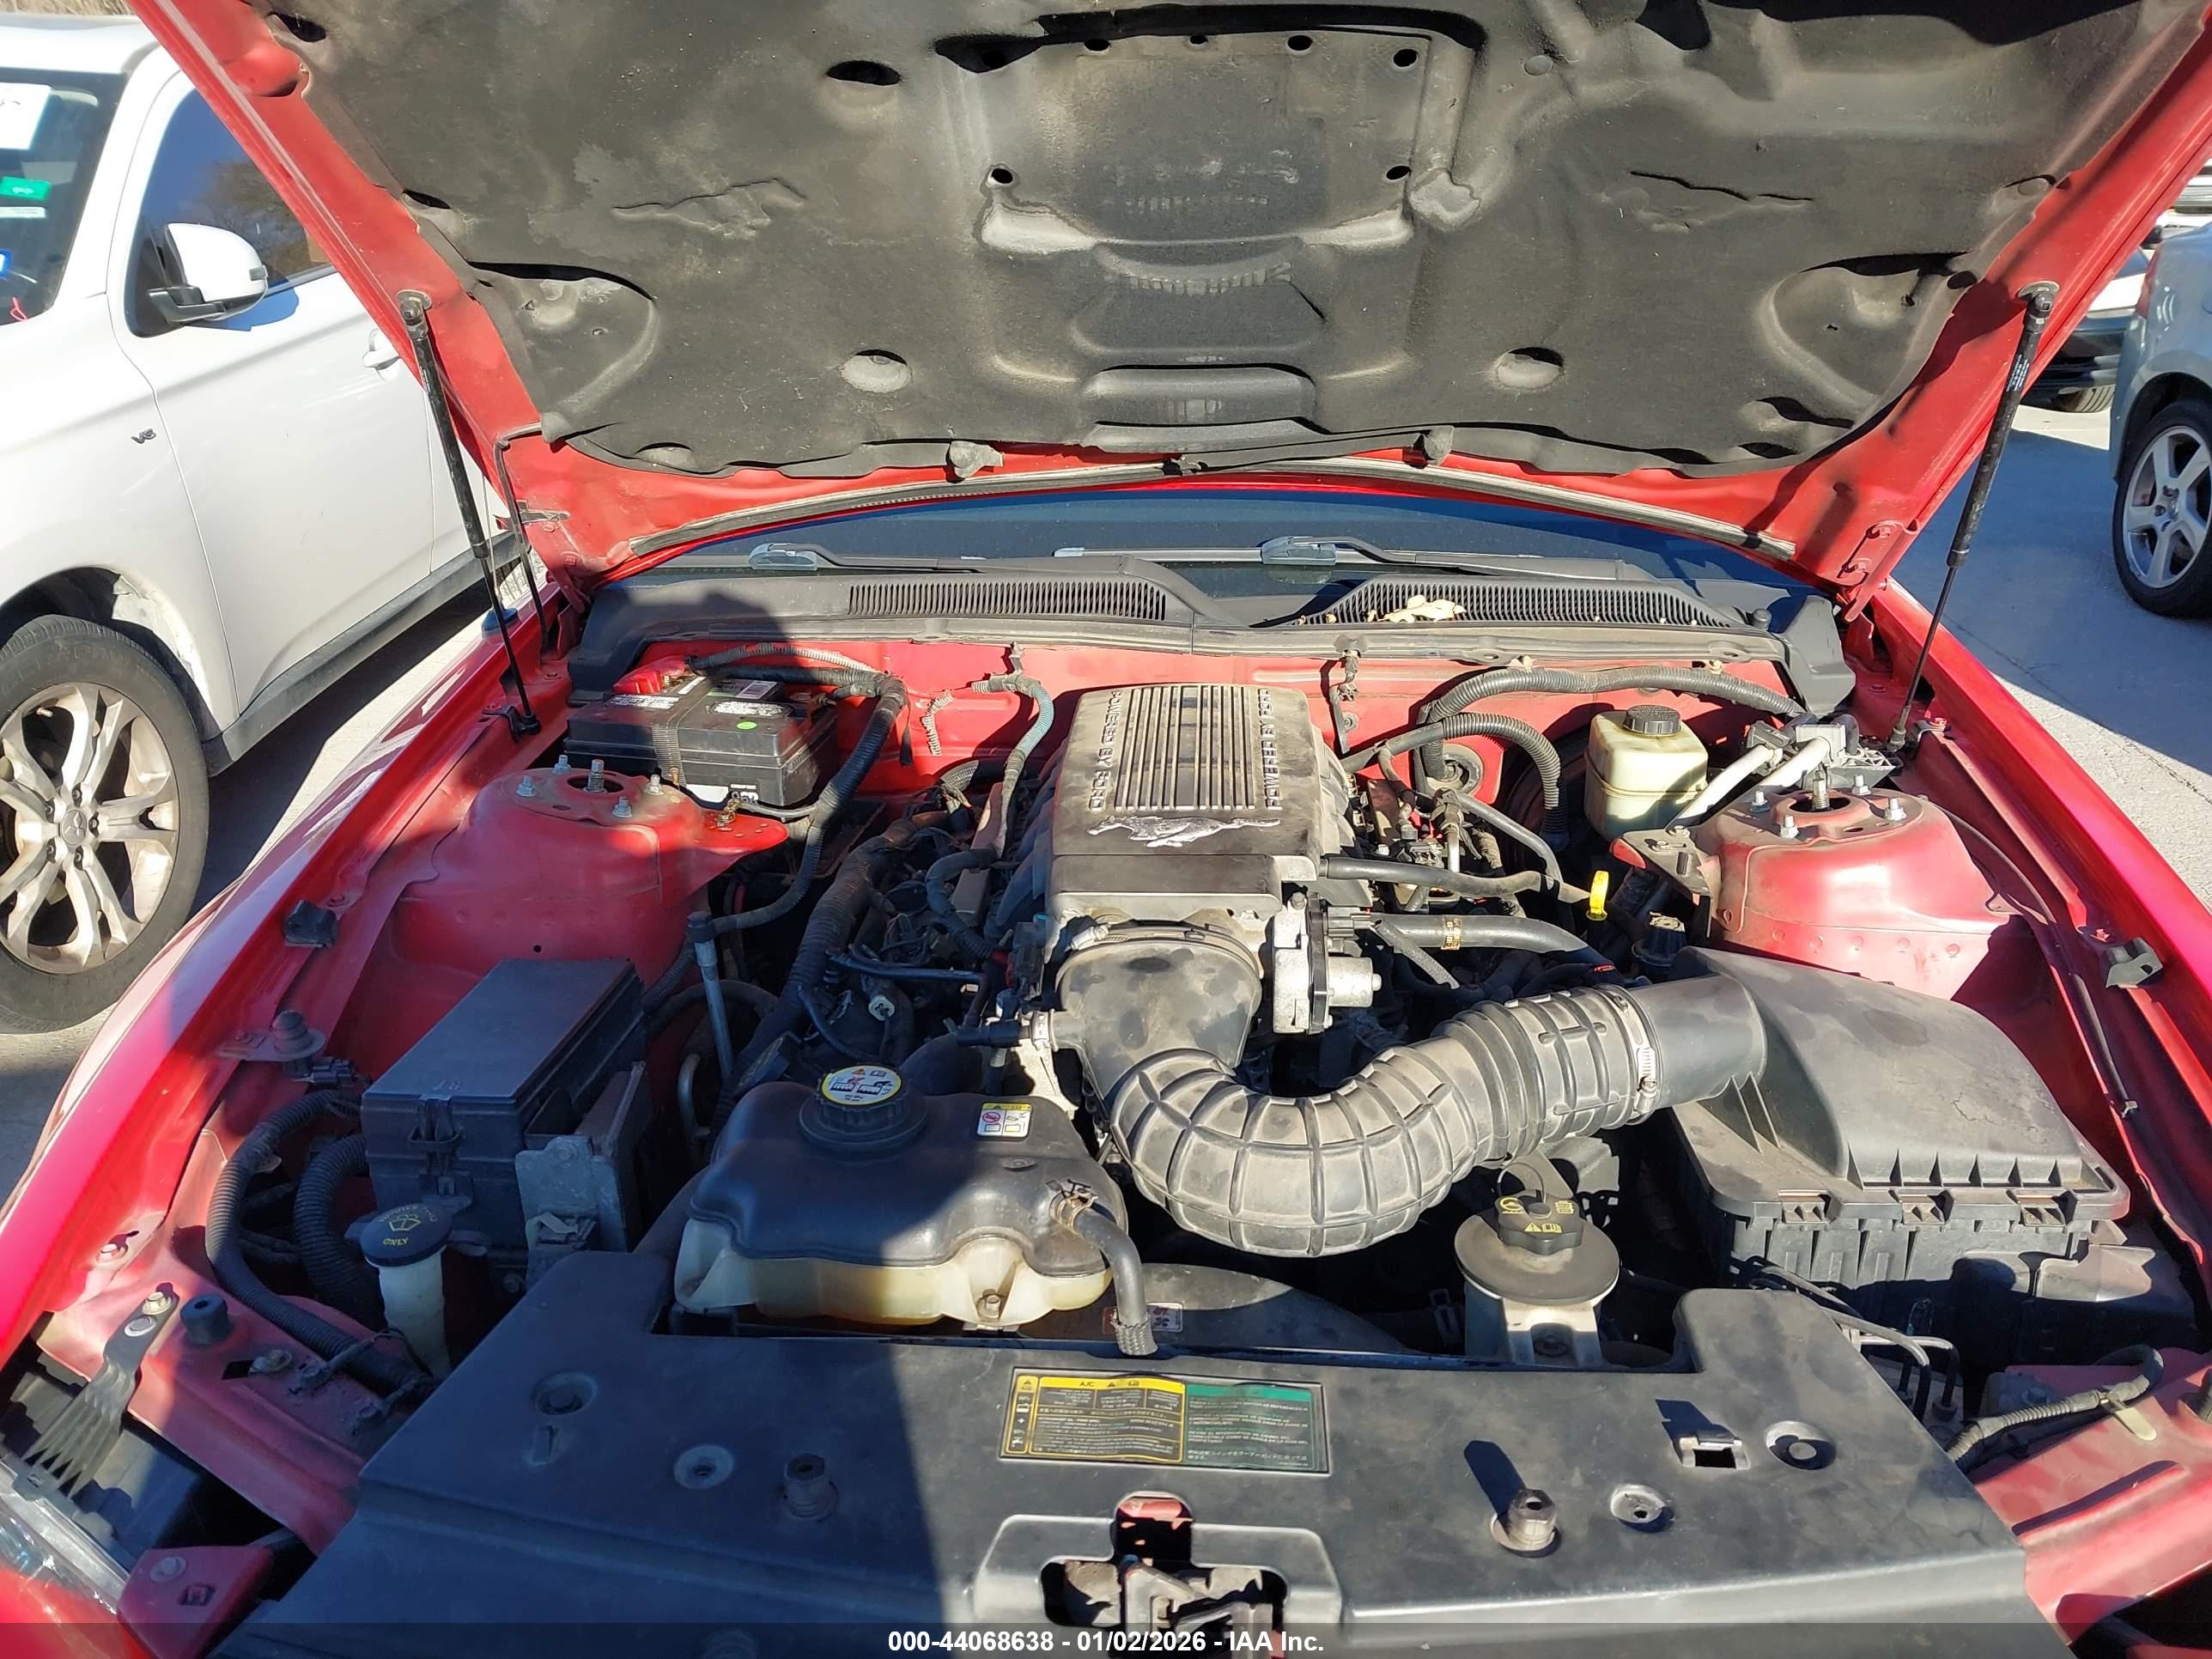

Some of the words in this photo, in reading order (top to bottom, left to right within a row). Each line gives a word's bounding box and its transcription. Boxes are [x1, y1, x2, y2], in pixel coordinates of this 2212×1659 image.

[131, 428, 156, 445] V6
[1101, 690, 1122, 745] POWERED
[1097, 748, 1114, 768] BY
[1261, 739, 1284, 811] POWERED
[1089, 770, 1112, 811] FORD
[382, 1236, 410, 1247] ONLY
